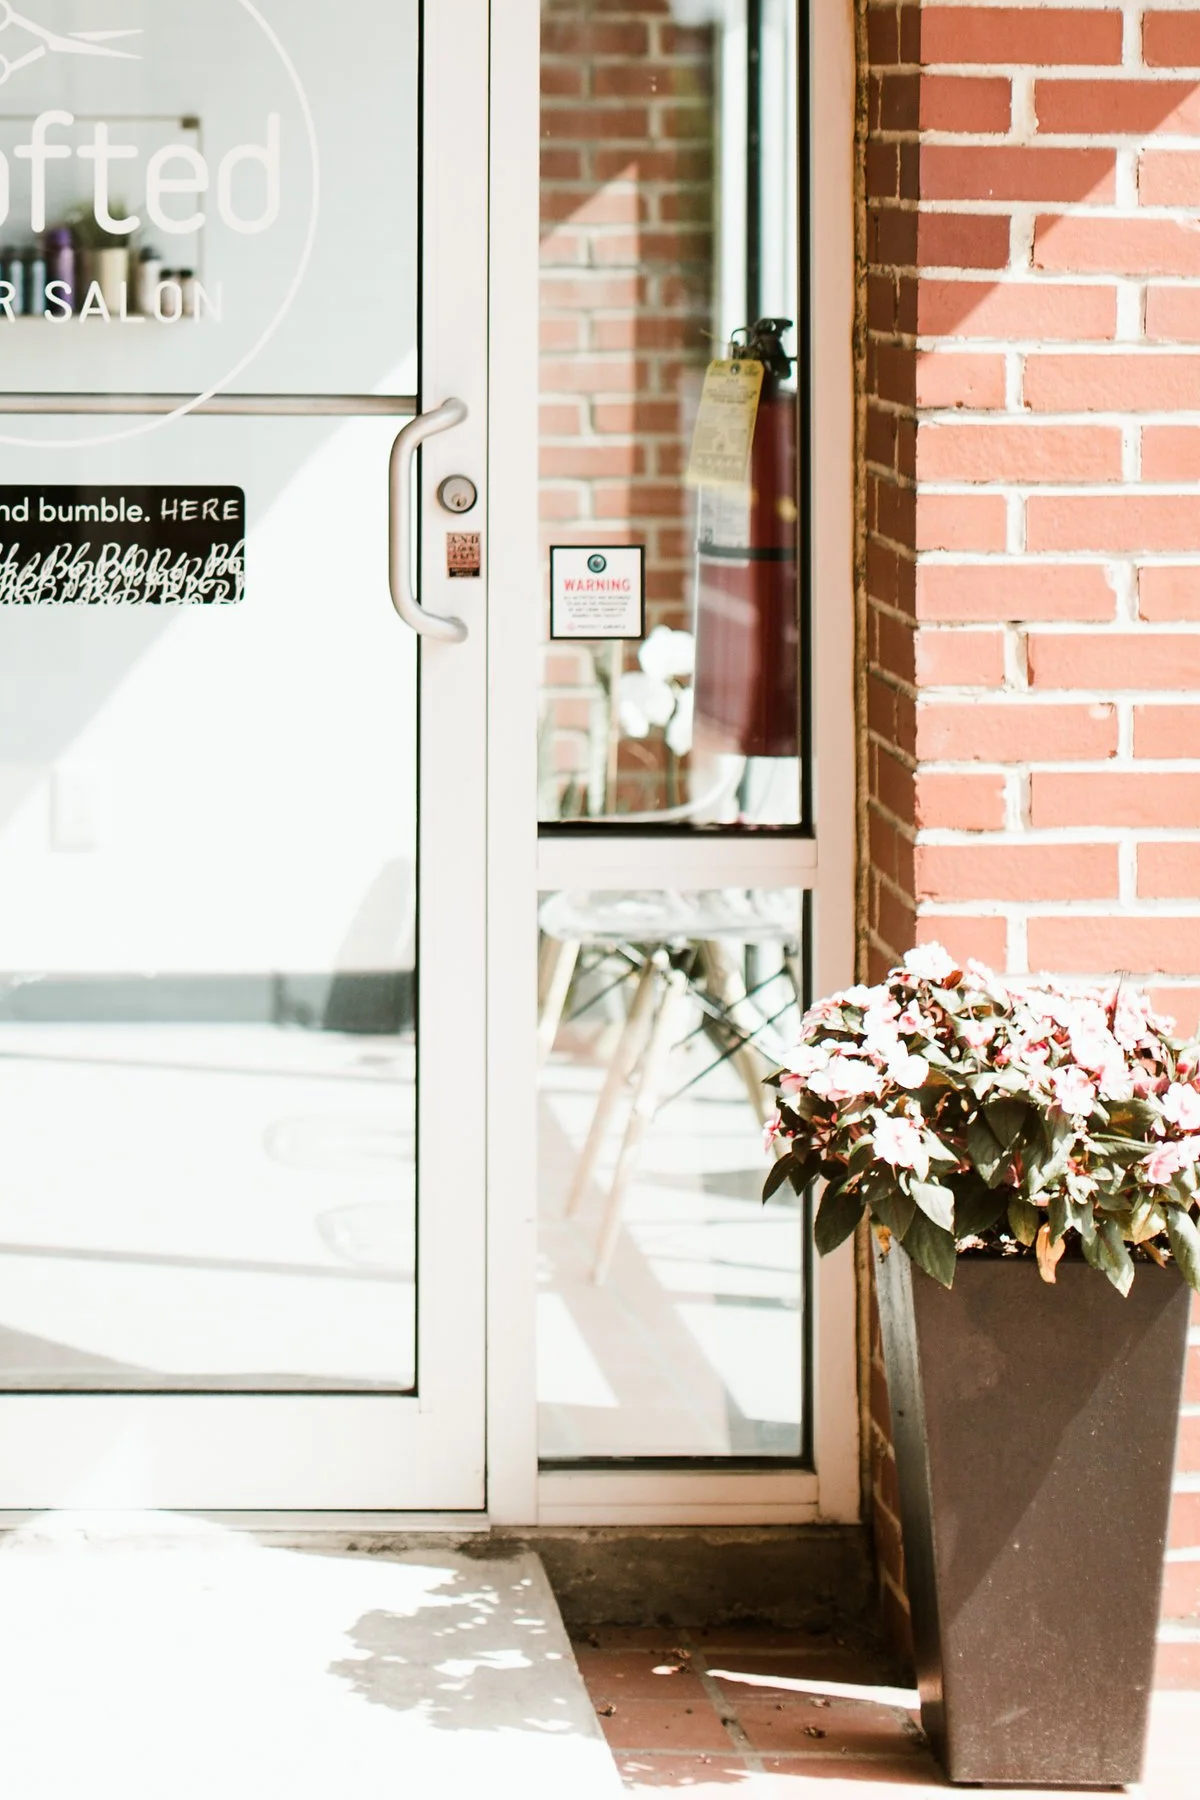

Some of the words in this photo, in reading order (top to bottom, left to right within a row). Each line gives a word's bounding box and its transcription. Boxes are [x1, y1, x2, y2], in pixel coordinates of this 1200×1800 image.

[44, 280, 223, 324] SALON
[39, 497, 151, 522] bumble.
[160, 498, 240, 522] HERE
[563, 579, 631, 592] WARNING
